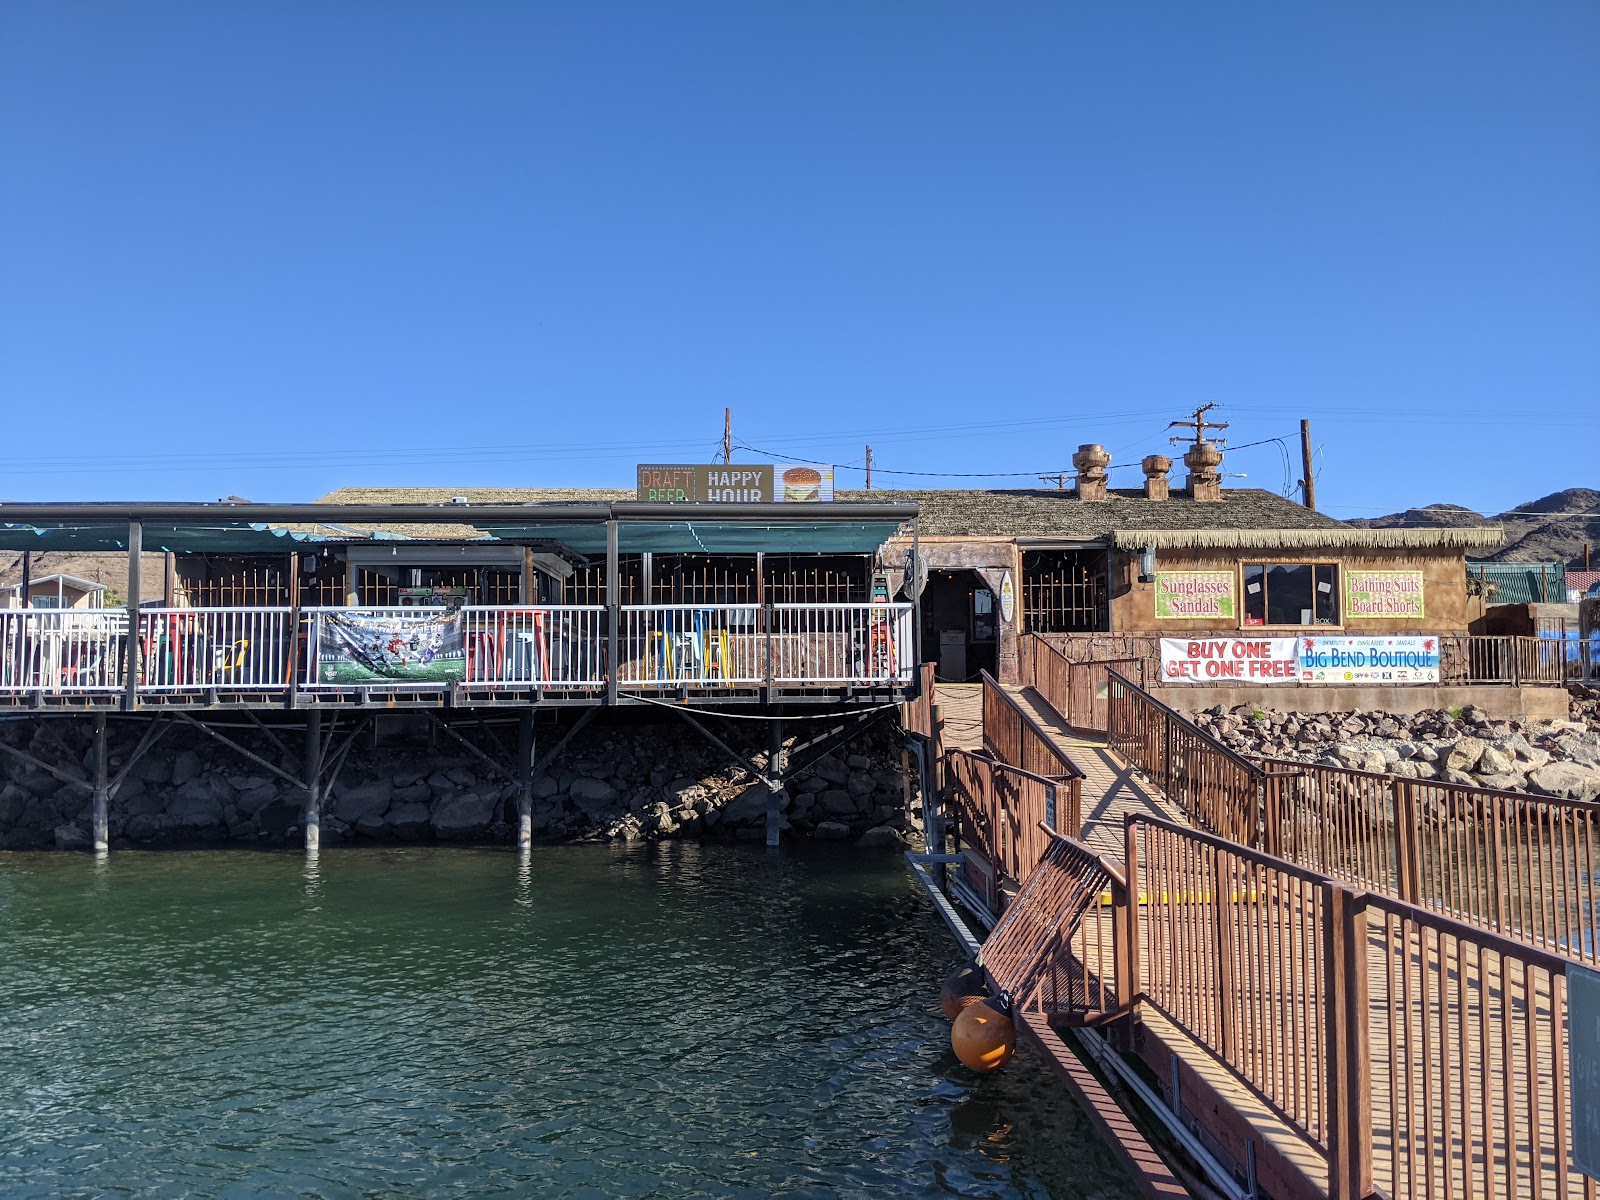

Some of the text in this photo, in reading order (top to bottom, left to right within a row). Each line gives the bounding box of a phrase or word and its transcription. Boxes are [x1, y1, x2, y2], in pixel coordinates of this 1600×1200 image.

[642, 471, 692, 488] DRAFT
[708, 471, 763, 486] HAPPY
[649, 488, 685, 501] BEER
[708, 488, 762, 502] HOUR
[1160, 578, 1229, 597] Sunglasses
[1351, 577, 1392, 596] Bathing
[1393, 577, 1419, 593] Suits
[1172, 597, 1219, 613] Sandals
[1351, 597, 1420, 613] Board Shorts
[1187, 641, 1271, 659] BUY ONE
[1305, 647, 1433, 671] BIG BEND BOUTIQUE
[1166, 660, 1296, 677] GET ONE FREE
